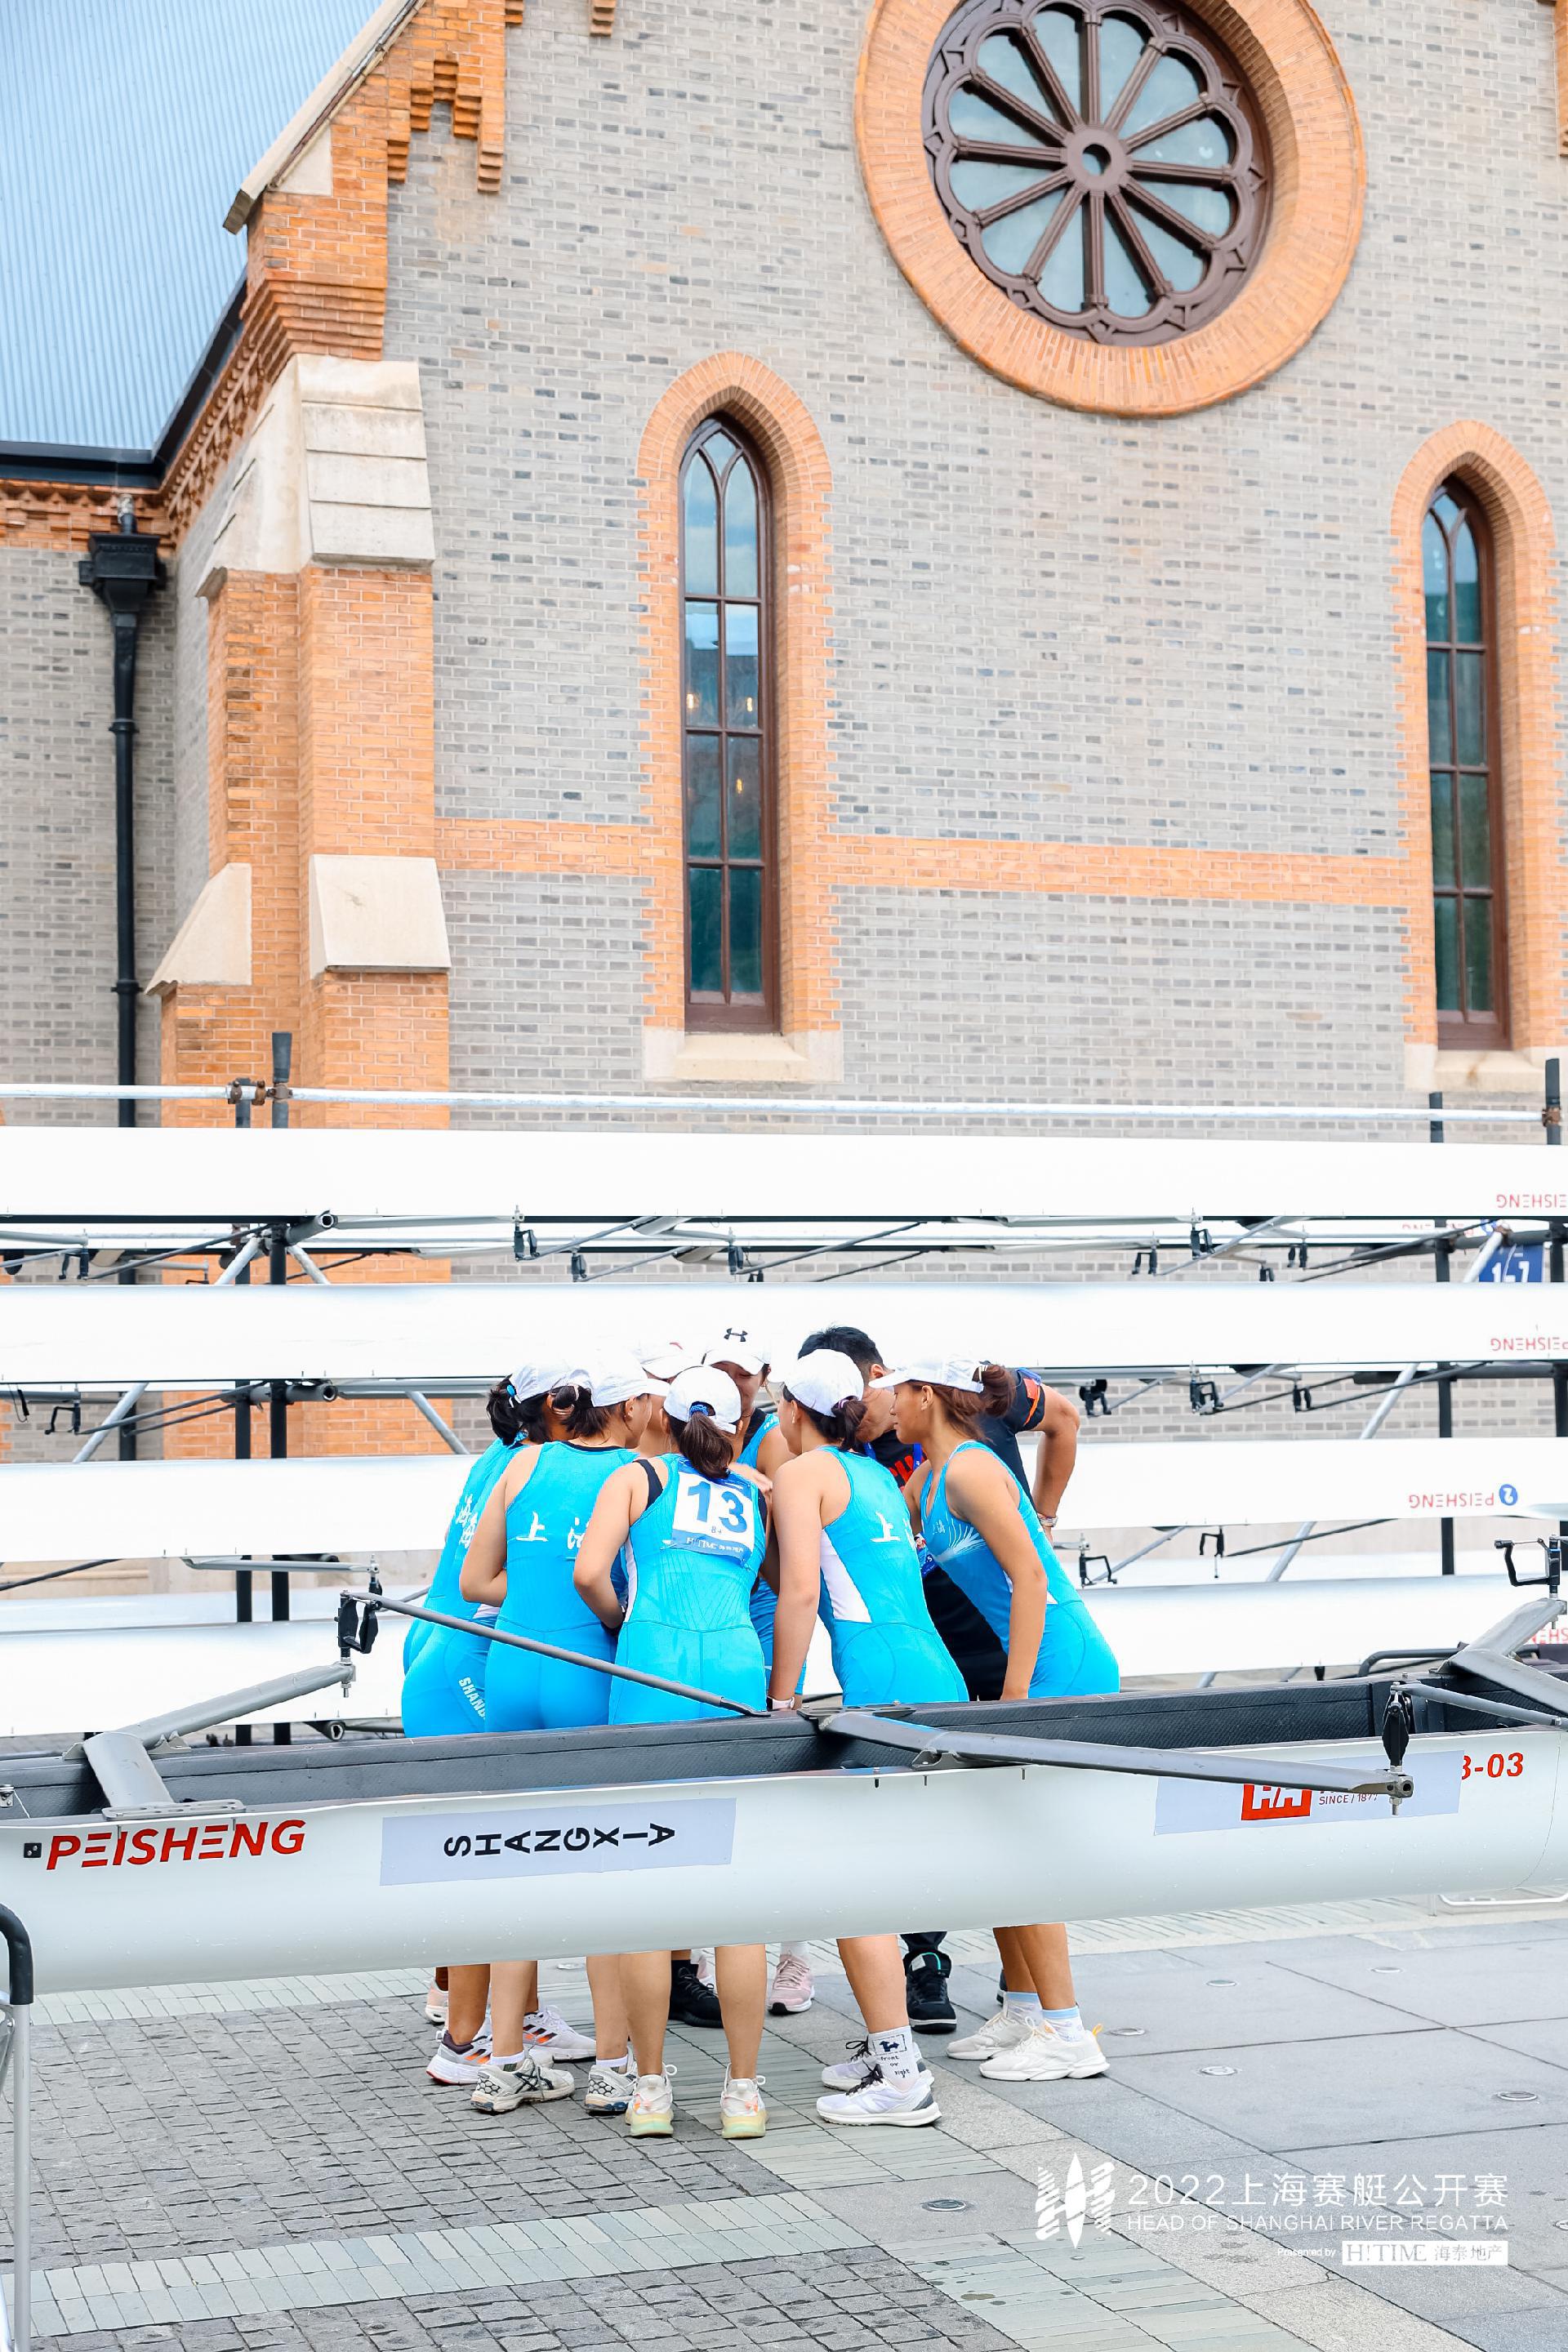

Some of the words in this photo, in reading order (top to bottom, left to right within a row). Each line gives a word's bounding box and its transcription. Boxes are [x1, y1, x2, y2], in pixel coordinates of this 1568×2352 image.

[1495, 1194, 1568, 1209] EISHENG
[688, 1481, 747, 1533] 13
[1409, 1493, 1494, 1508] PEISHENG
[458, 1677, 486, 1721] SHANG
[1318, 1794, 1348, 1806] SINCE
[46, 1820, 306, 1871] PEISHENG
